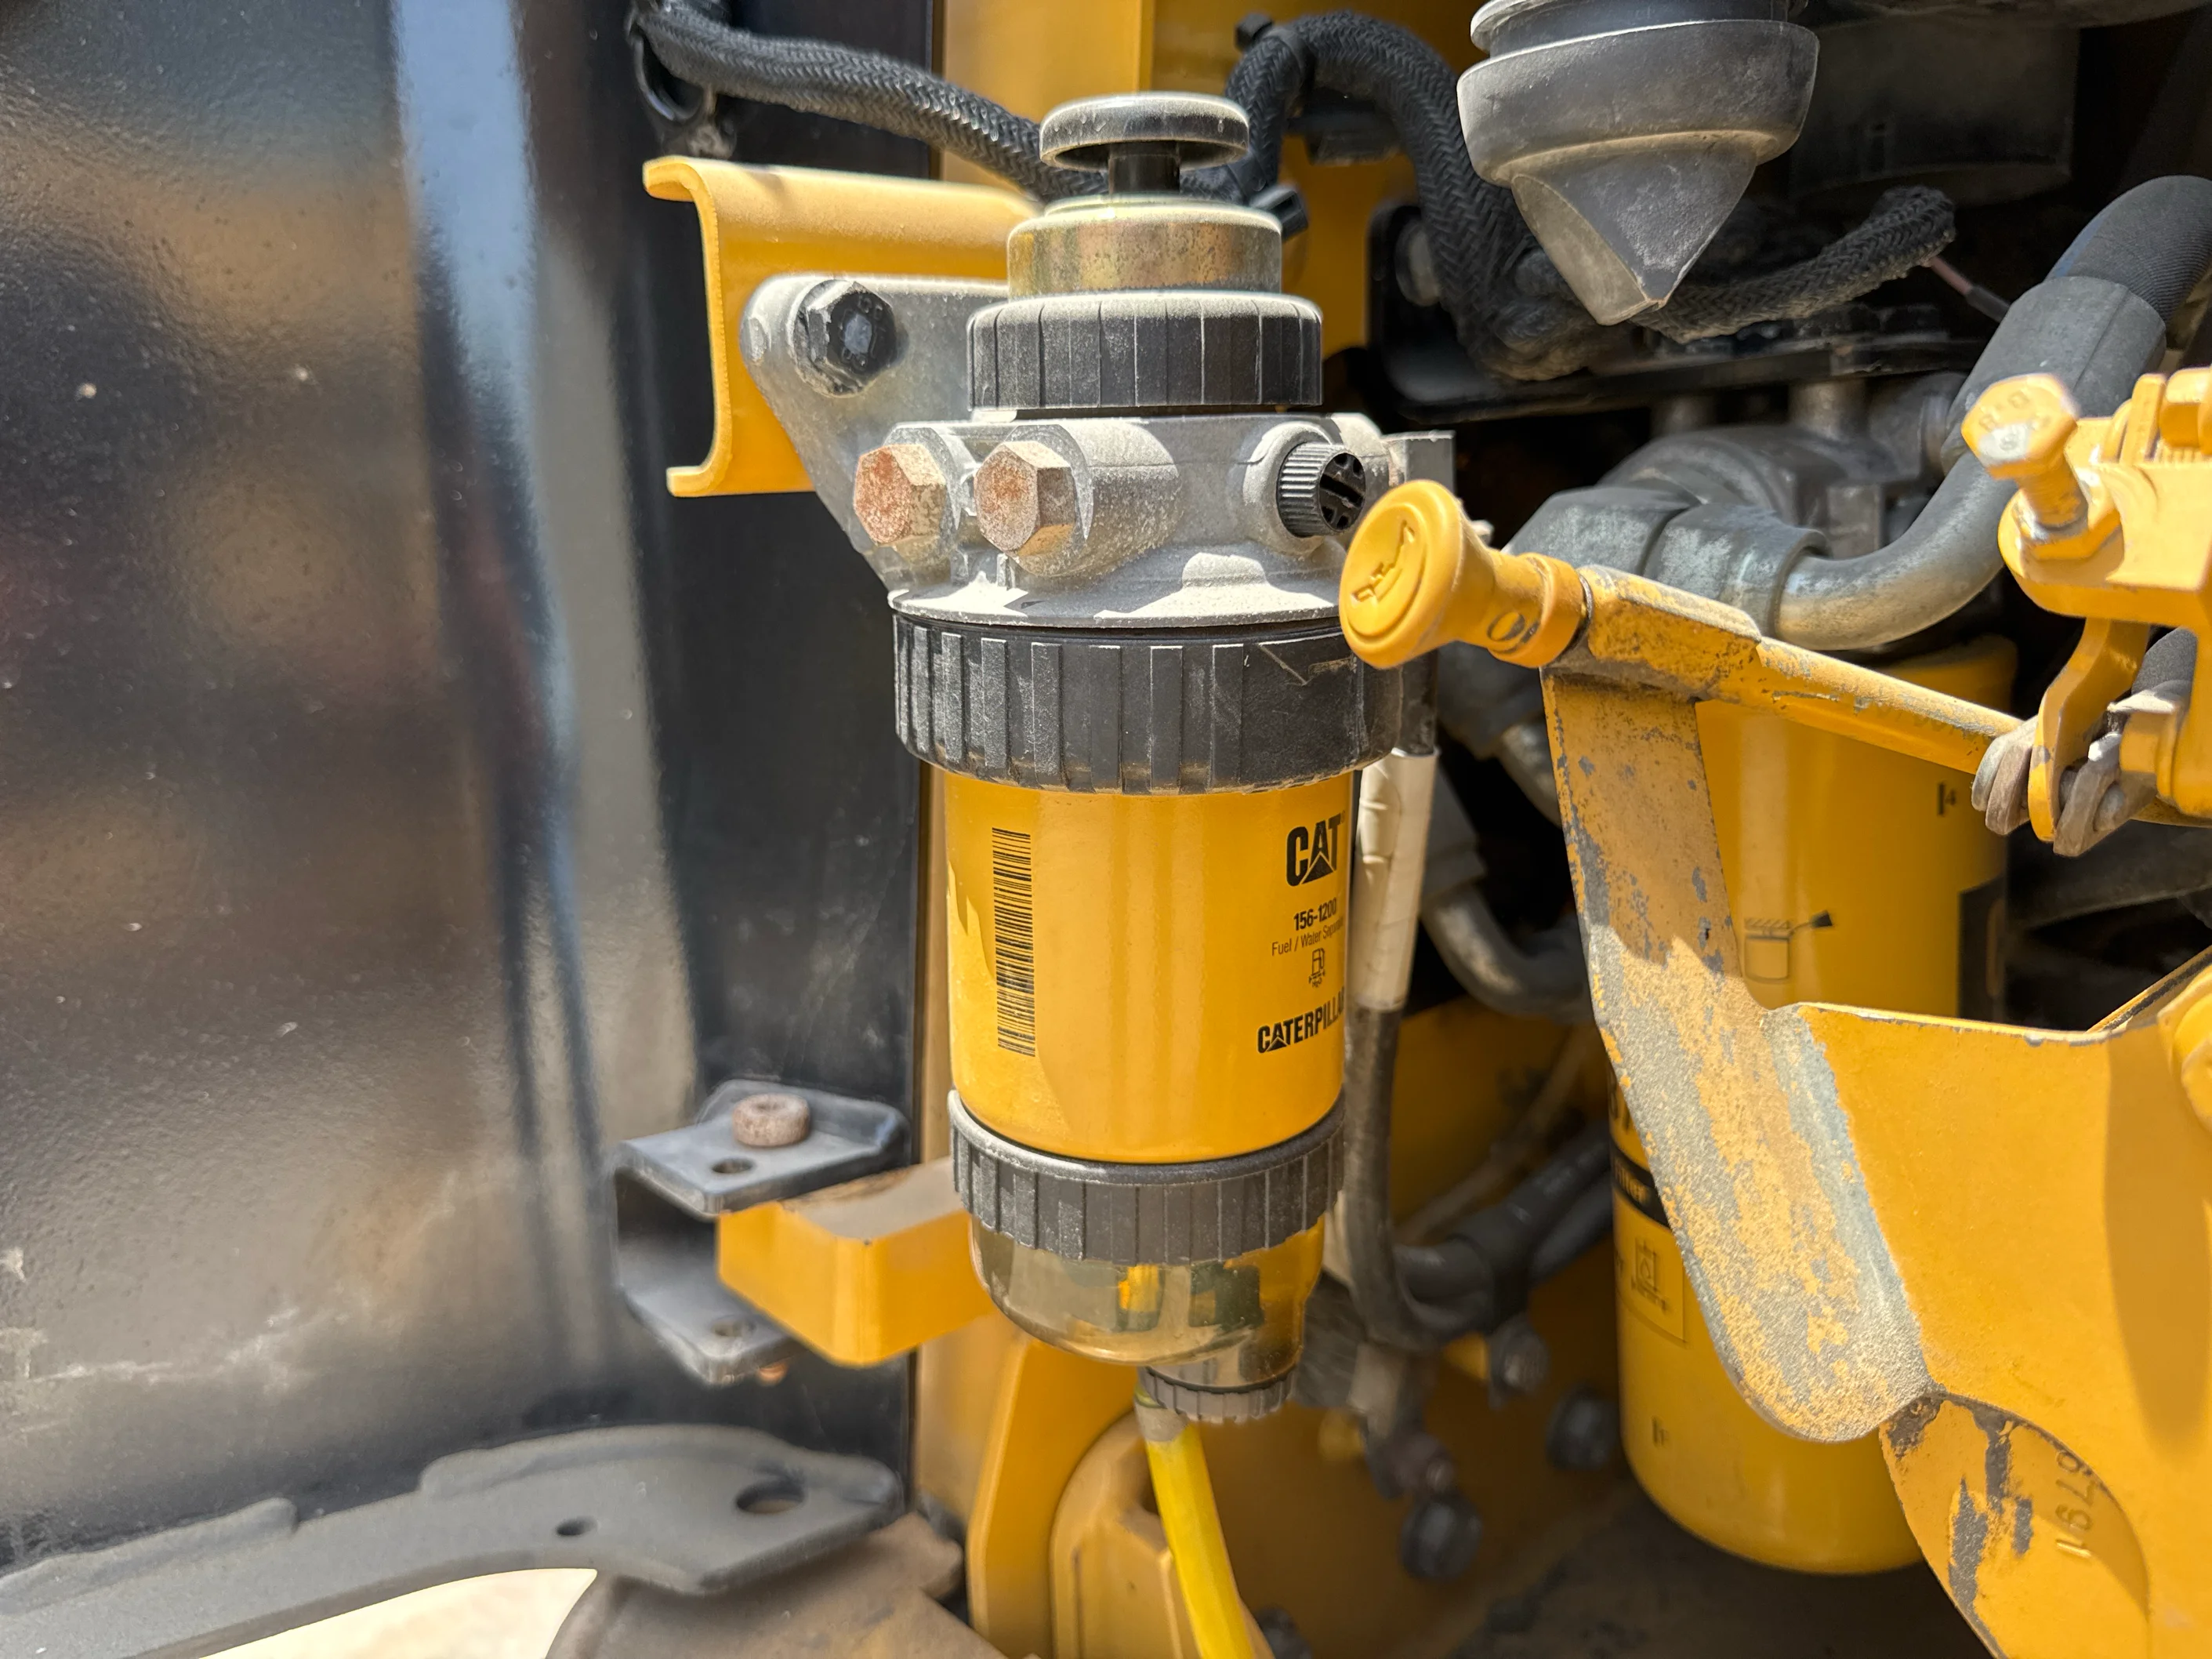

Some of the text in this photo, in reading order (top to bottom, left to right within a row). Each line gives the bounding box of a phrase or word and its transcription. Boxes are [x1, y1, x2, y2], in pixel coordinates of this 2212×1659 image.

[1286, 812, 1341, 887] CAT
[1293, 896, 1337, 931] 156-1200
[1271, 938, 1293, 957] Fuel
[1300, 931, 1322, 949] Water
[1256, 986, 1345, 1055] CATERPILLA
